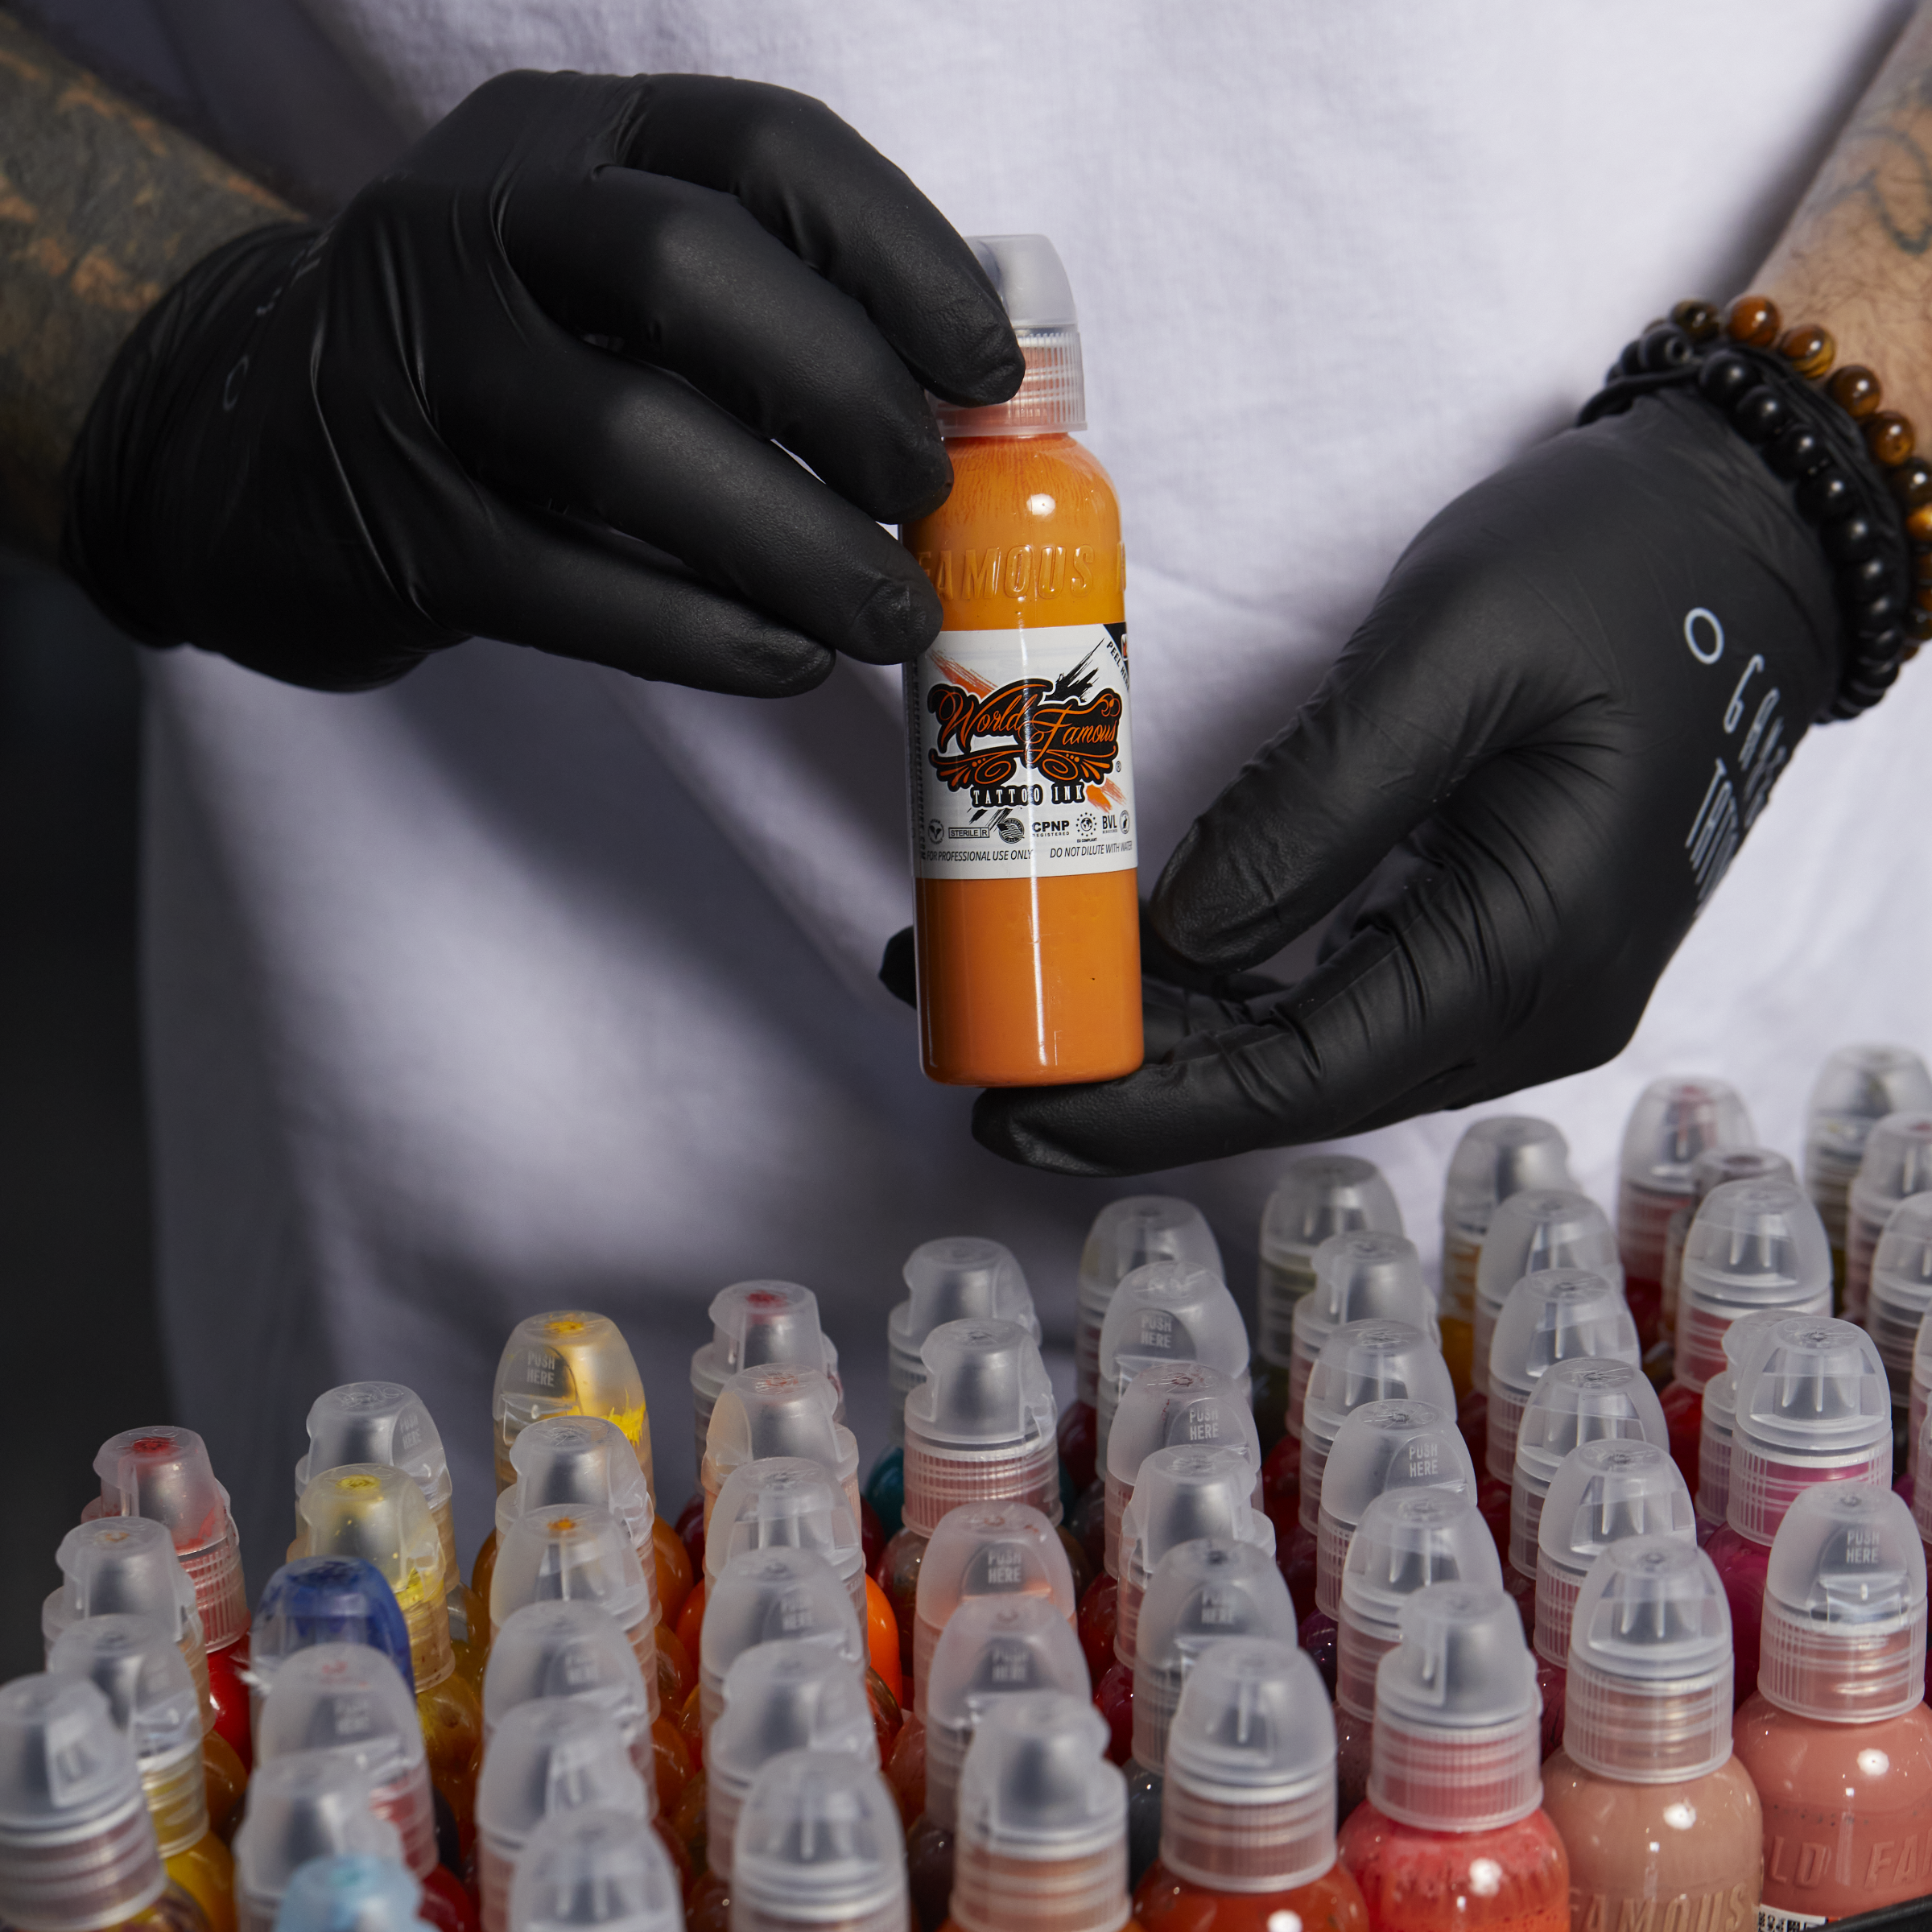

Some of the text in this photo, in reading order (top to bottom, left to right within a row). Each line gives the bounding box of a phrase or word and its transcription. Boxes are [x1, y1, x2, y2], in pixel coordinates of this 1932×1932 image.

[1106, 641, 1121, 667] PEEL
[932, 684, 1121, 764] World Famous
[972, 784, 1084, 806] TATTOO INK
[1032, 820, 1070, 832] CPNP
[1102, 815, 1117, 830] BVL
[951, 829, 979, 837] STERILE
[927, 849, 1033, 861] FOR PROFESSIONAL USE ONLY
[1050, 848, 1063, 858] DO
[1064, 846, 1080, 857] NOT
[1081, 844, 1105, 856] DILUTE
[1105, 842, 1120, 853] WITH
[1141, 1314, 1172, 1332] PUSH
[1140, 1330, 1171, 1349] HERE
[527, 1352, 555, 1371] PUSH
[526, 1368, 555, 1388] HERE
[1189, 1408, 1219, 1424] PUSH
[1190, 1422, 1220, 1441] HERE
[1409, 1443, 1439, 1461] PUSH
[1410, 1459, 1439, 1478] HERE
[1846, 1530, 1880, 1546] PUSH
[988, 1550, 1022, 1566] PUSH
[1846, 1547, 1879, 1563] HERE
[988, 1567, 1022, 1584] HERE
[1864, 1826, 1932, 1889] FA
